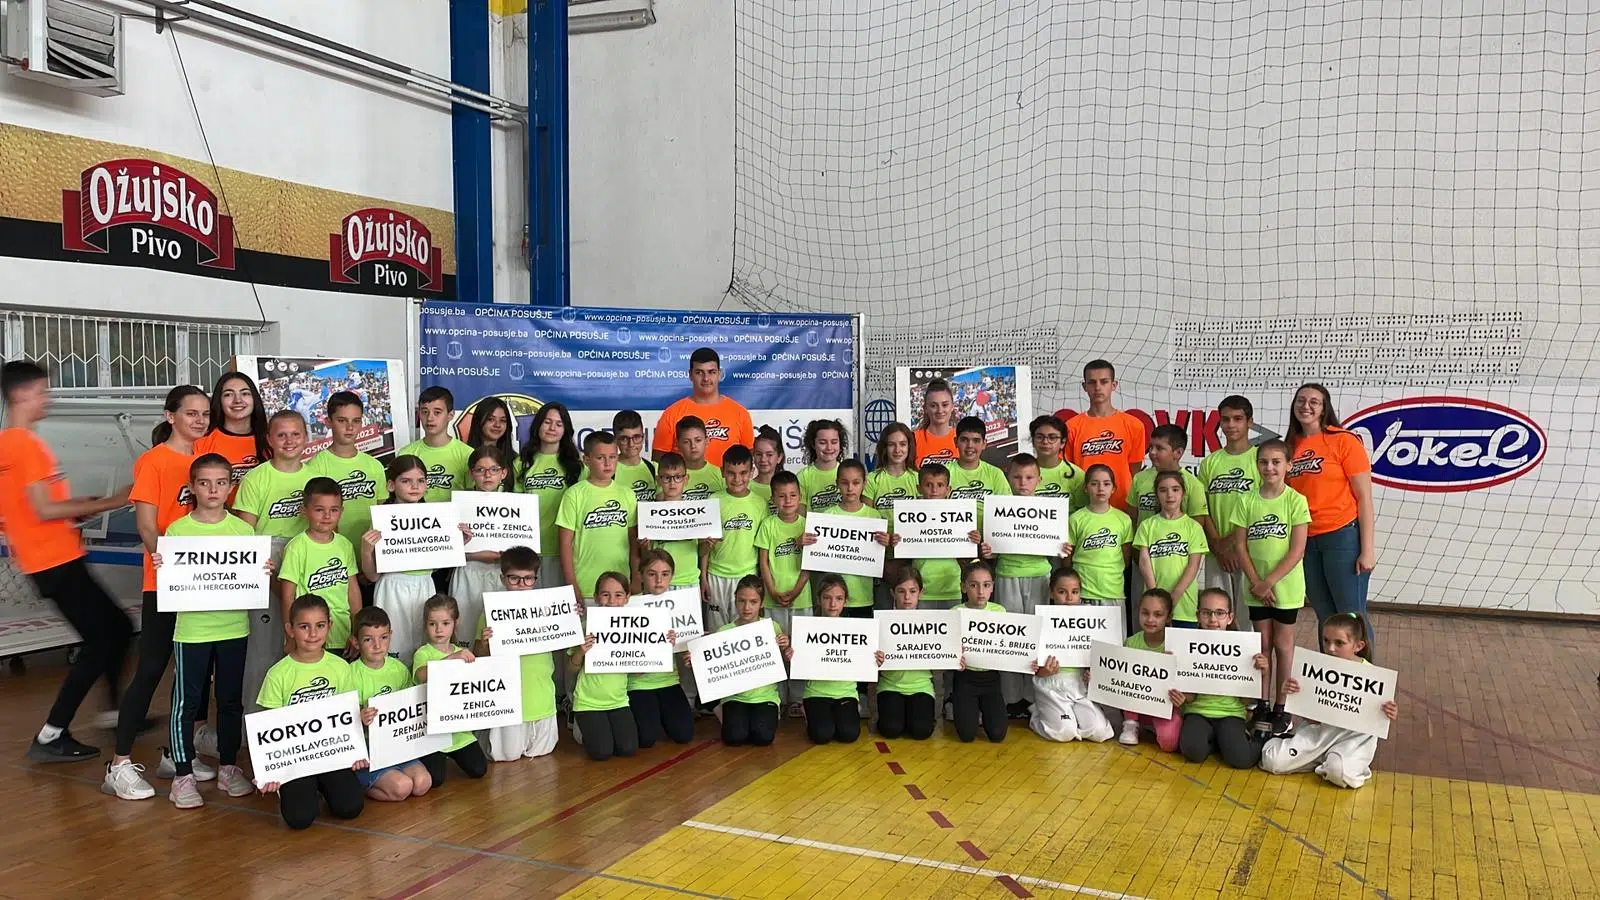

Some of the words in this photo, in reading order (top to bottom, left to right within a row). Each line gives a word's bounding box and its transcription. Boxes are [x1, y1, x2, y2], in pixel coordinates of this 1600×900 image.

[90, 166, 214, 236] Ožujsko
[131, 228, 182, 260] Pivo
[347, 213, 430, 265] Ožujsko
[374, 263, 408, 288] Pivo
[425, 327, 528, 340] www.opcina-posusje.ba
[472, 348, 572, 360] www.opcina-posusje.ba
[476, 506, 520, 518] KWON
[650, 506, 706, 516] POSKOK
[898, 512, 927, 523] CRO
[940, 511, 973, 523] STAR
[994, 507, 1057, 520] MAGONE
[391, 515, 441, 531] ŠUJICA
[469, 521, 495, 530] LOPČE
[503, 523, 533, 532] ZENICA
[671, 522, 712, 530] HERCEGOVINA
[1013, 523, 1039, 531] LIVNO
[814, 526, 876, 542] STUDENT
[919, 528, 953, 536] MOSTAR
[1017, 532, 1061, 540] HERCEGOVINA
[384, 534, 451, 546] TOMISLAVGRAD
[409, 545, 454, 553] HERCEGOVINA
[827, 544, 860, 553] MOSTAR
[174, 551, 257, 565] ZRINJSKI
[835, 553, 876, 562] HERCEGOVINA
[193, 572, 237, 581] MOSTAR
[169, 584, 196, 592] BOSNA
[203, 583, 260, 591] HERCEGOVINA
[491, 608, 529, 622] CENTAR
[530, 600, 572, 619] HADŽIĆI
[610, 616, 650, 628] HTKD
[890, 622, 948, 635] OLIMPIC
[968, 620, 1027, 637] POSKOK
[1051, 617, 1107, 630] TAEGUK
[515, 623, 560, 636] SARAJEVO
[501, 638, 524, 646] BOSNA
[529, 630, 577, 643] HERCEGOVINA
[806, 632, 868, 646] MONTER
[961, 635, 993, 646] OČERIN
[1008, 641, 1036, 650] BRIJEG
[703, 638, 751, 662] BUŠKO
[755, 635, 769, 648] B.
[896, 643, 942, 651] SARAJEVO
[986, 648, 1029, 657] HERCEGOVINA
[1189, 642, 1242, 657] FOKUS
[610, 650, 646, 658] FOJNICA
[707, 651, 772, 675] TOMISLAVGRAD
[1099, 656, 1129, 673] NOVI
[1132, 663, 1169, 680] GRAD
[1192, 662, 1238, 673] SARAJEVO
[707, 674, 729, 684] BOSNA
[733, 660, 776, 677] HERCEGOVINA
[1177, 670, 1200, 678] BOSNA
[1205, 672, 1254, 682] HERCEGOVINA
[1110, 677, 1152, 693] SARAJEVO
[1302, 662, 1384, 696] IMOTSKI
[450, 678, 506, 696] ZENICA
[1097, 684, 1117, 695] BOSNA
[1120, 689, 1166, 704] HERCEGOVINA
[1314, 686, 1362, 706] IMOTSKI
[462, 699, 496, 710] ZENICA
[1318, 697, 1360, 714] HRVATSKA
[439, 713, 465, 721] BOSNA
[470, 707, 514, 719] HERCEGOVINA
[257, 718, 323, 746] KORYO
[327, 711, 353, 728] TG
[406, 731, 425, 742] SRBIJA
[265, 733, 351, 761] TOMISLAVGRAD
[264, 759, 293, 772] BOSNA
[299, 744, 356, 763] HERCEGOVINA
